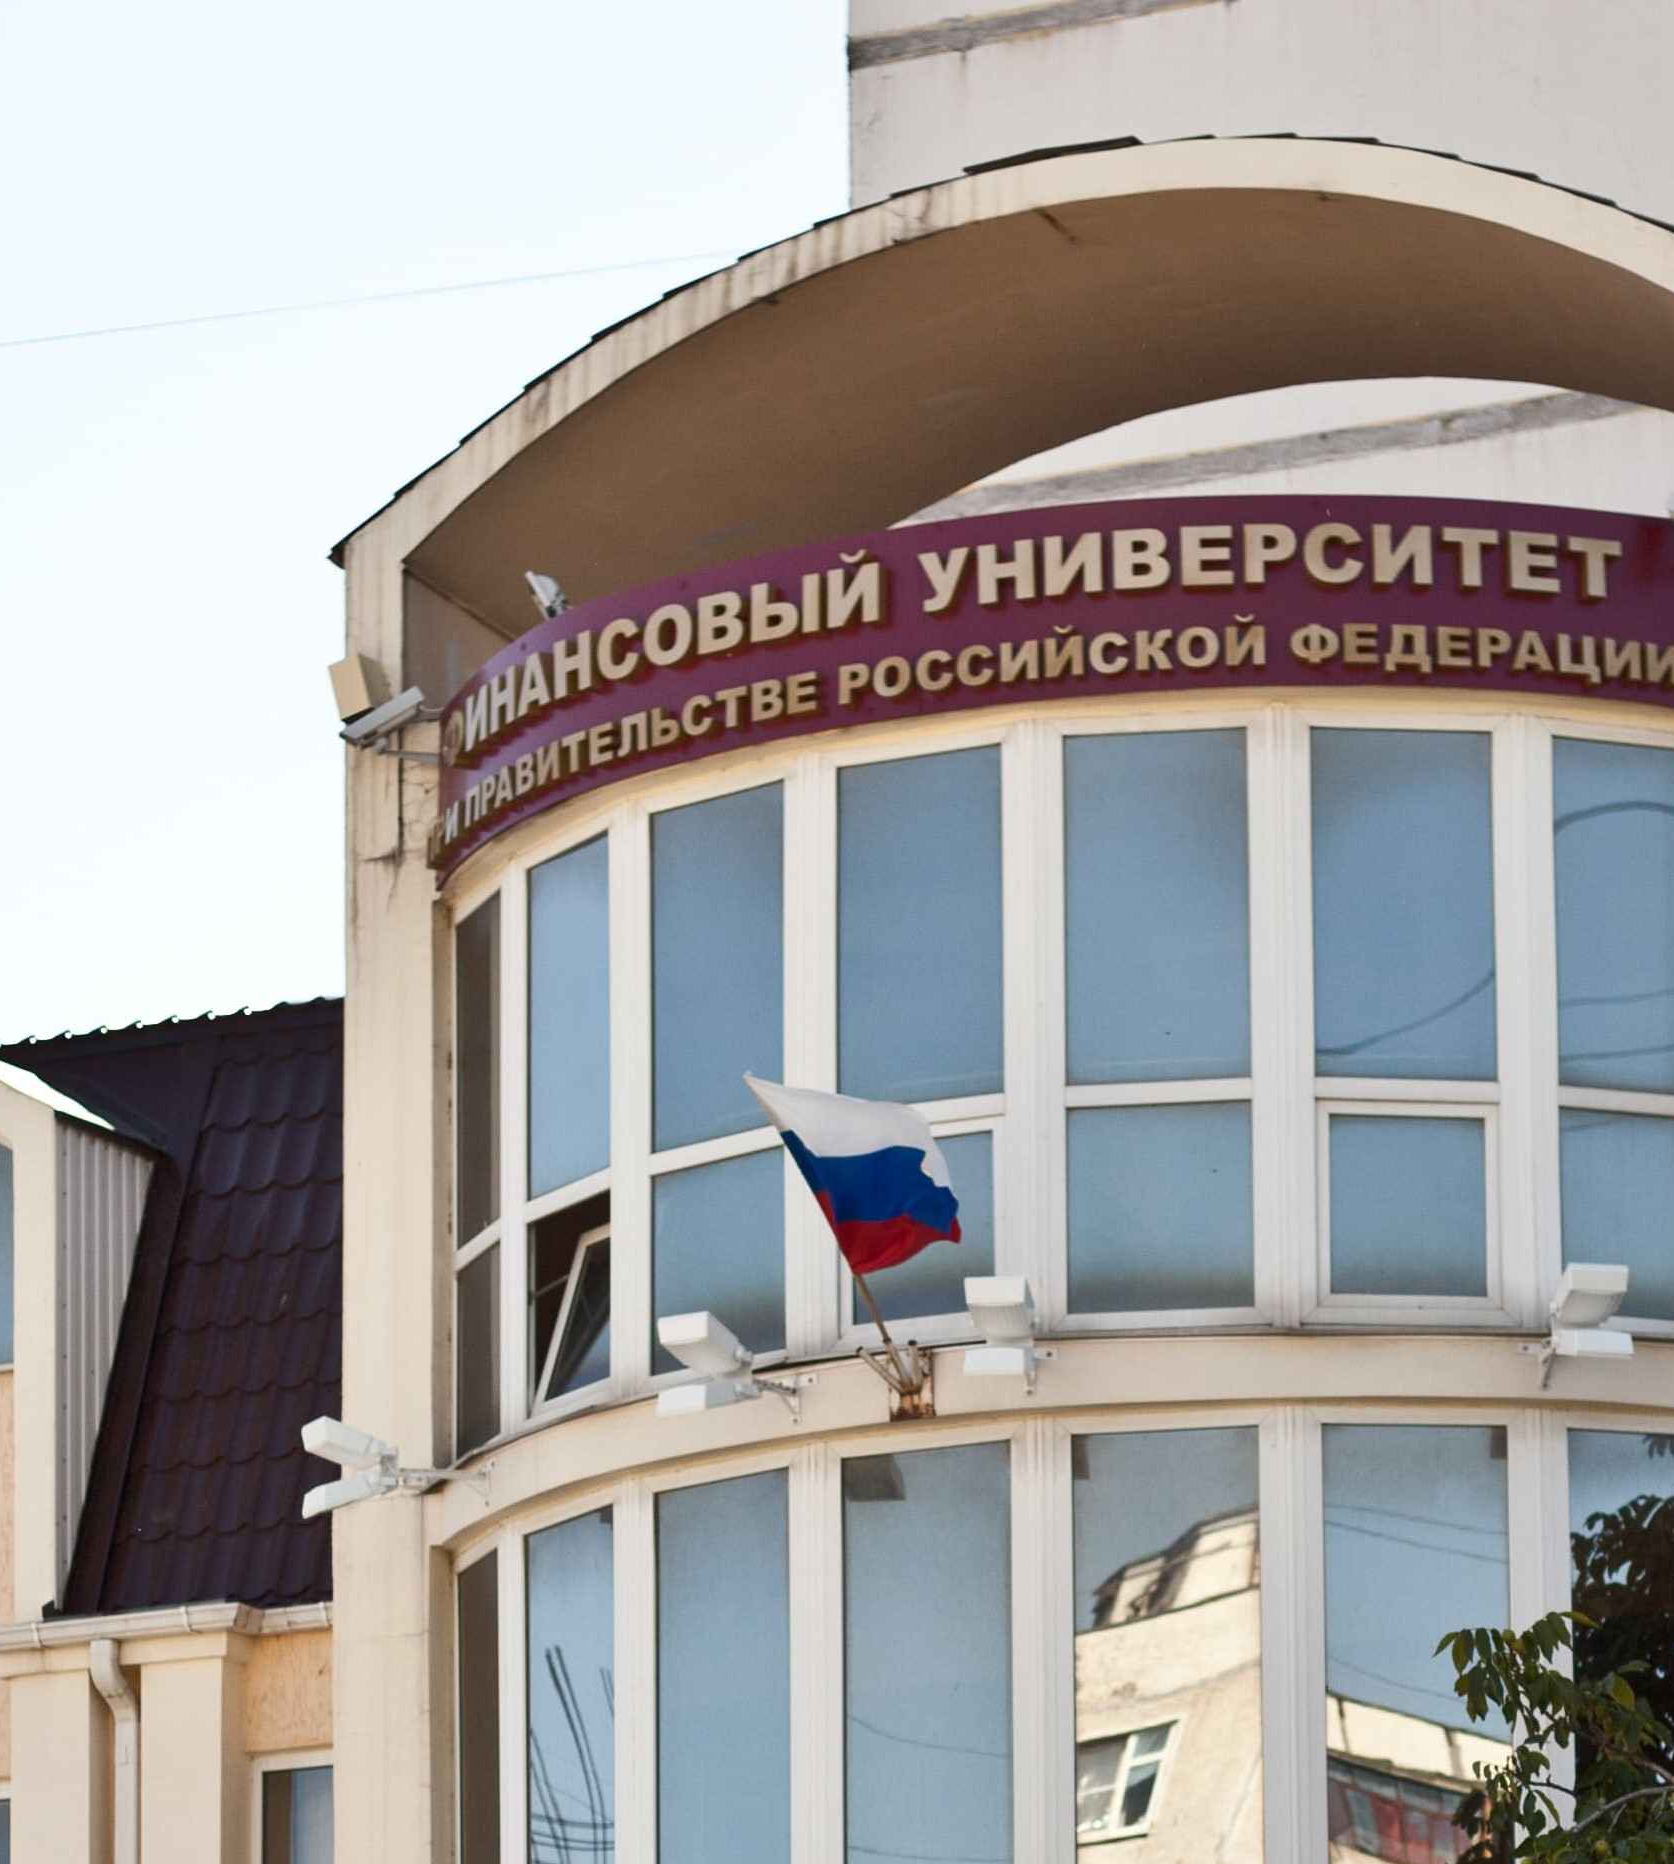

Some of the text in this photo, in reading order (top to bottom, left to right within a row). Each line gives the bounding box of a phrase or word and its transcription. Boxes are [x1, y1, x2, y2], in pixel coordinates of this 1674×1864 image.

[917, 522, 1623, 613] УНИВЕРСИТЕТ
[463, 670, 818, 828] ПРАВИТЕЛЬСТВЕ
[837, 613, 1267, 706] РОССИЙСКОЙ
